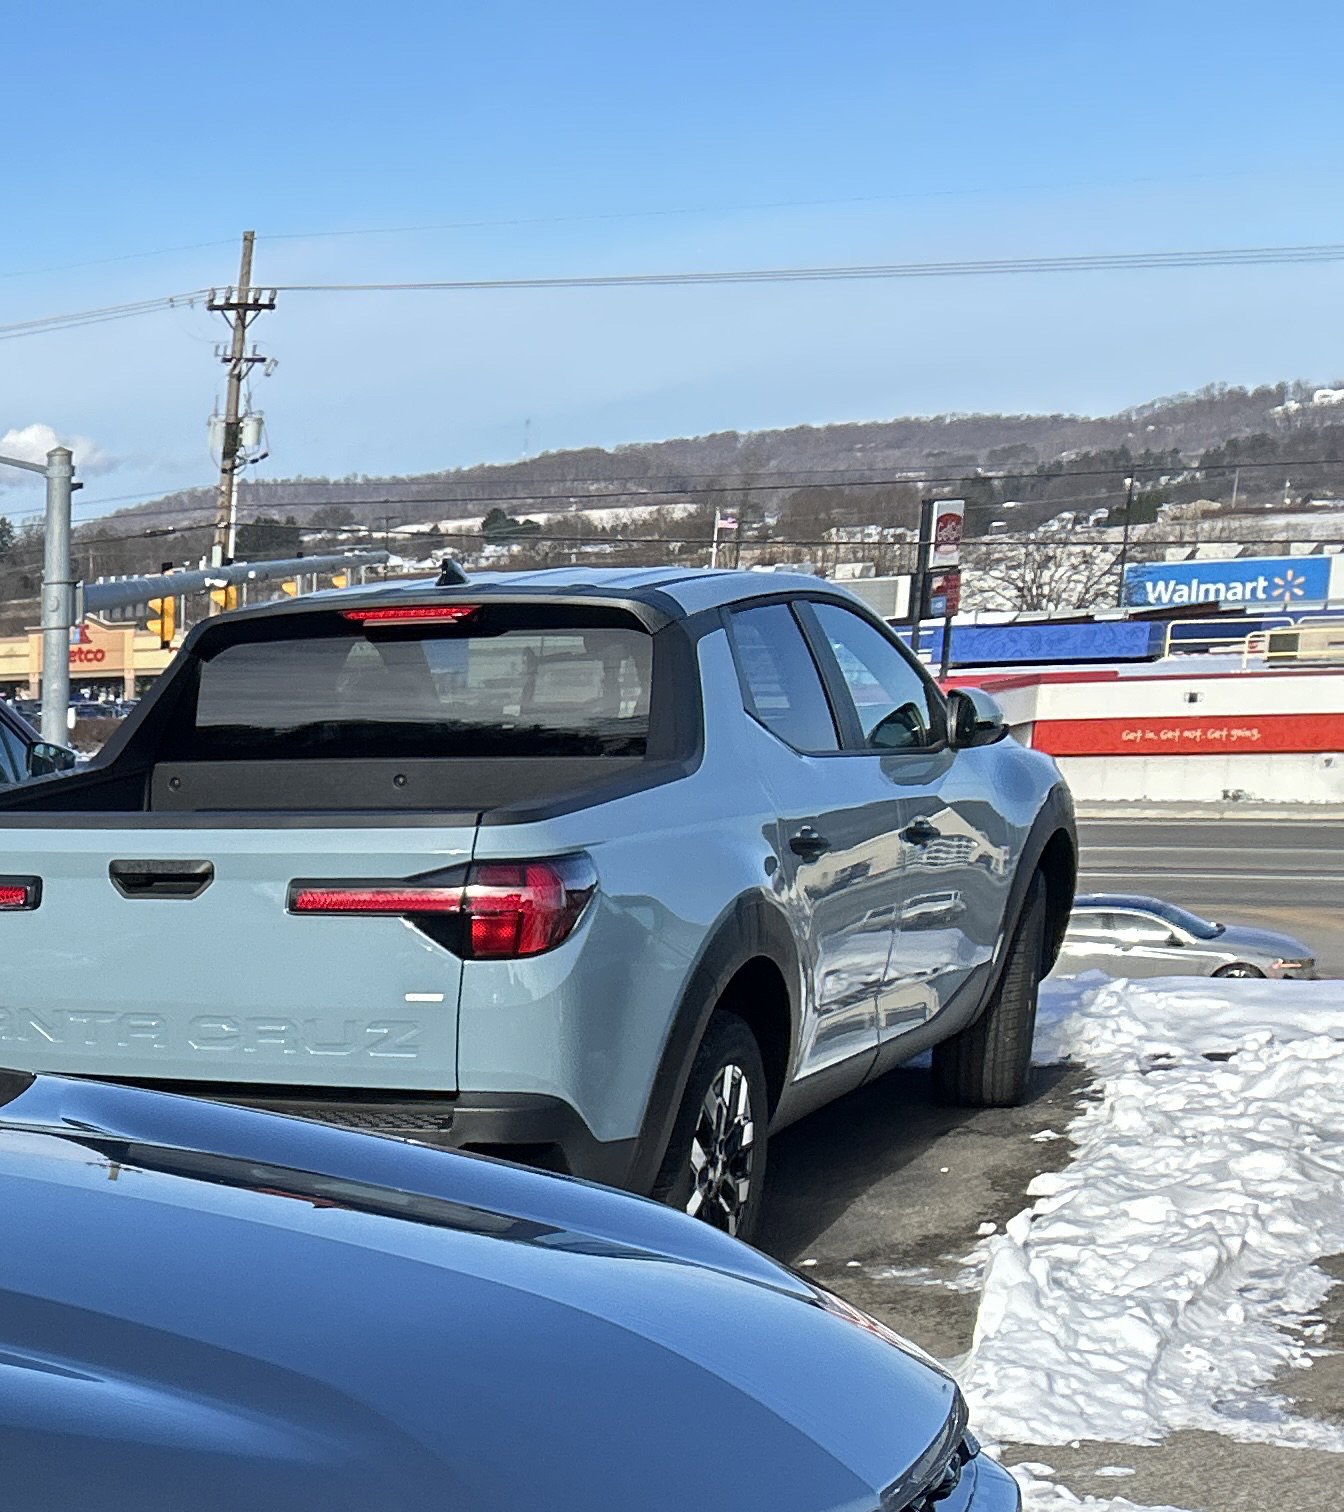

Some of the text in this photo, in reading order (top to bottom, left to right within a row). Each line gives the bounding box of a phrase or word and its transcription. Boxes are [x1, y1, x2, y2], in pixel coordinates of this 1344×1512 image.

[1145, 576, 1269, 604] Walmart
[69, 647, 106, 663] etco
[1122, 729, 1143, 742] Get
[1160, 728, 1181, 742] Get
[1207, 727, 1228, 741] Get
[186, 1014, 424, 1060] CRUZ
